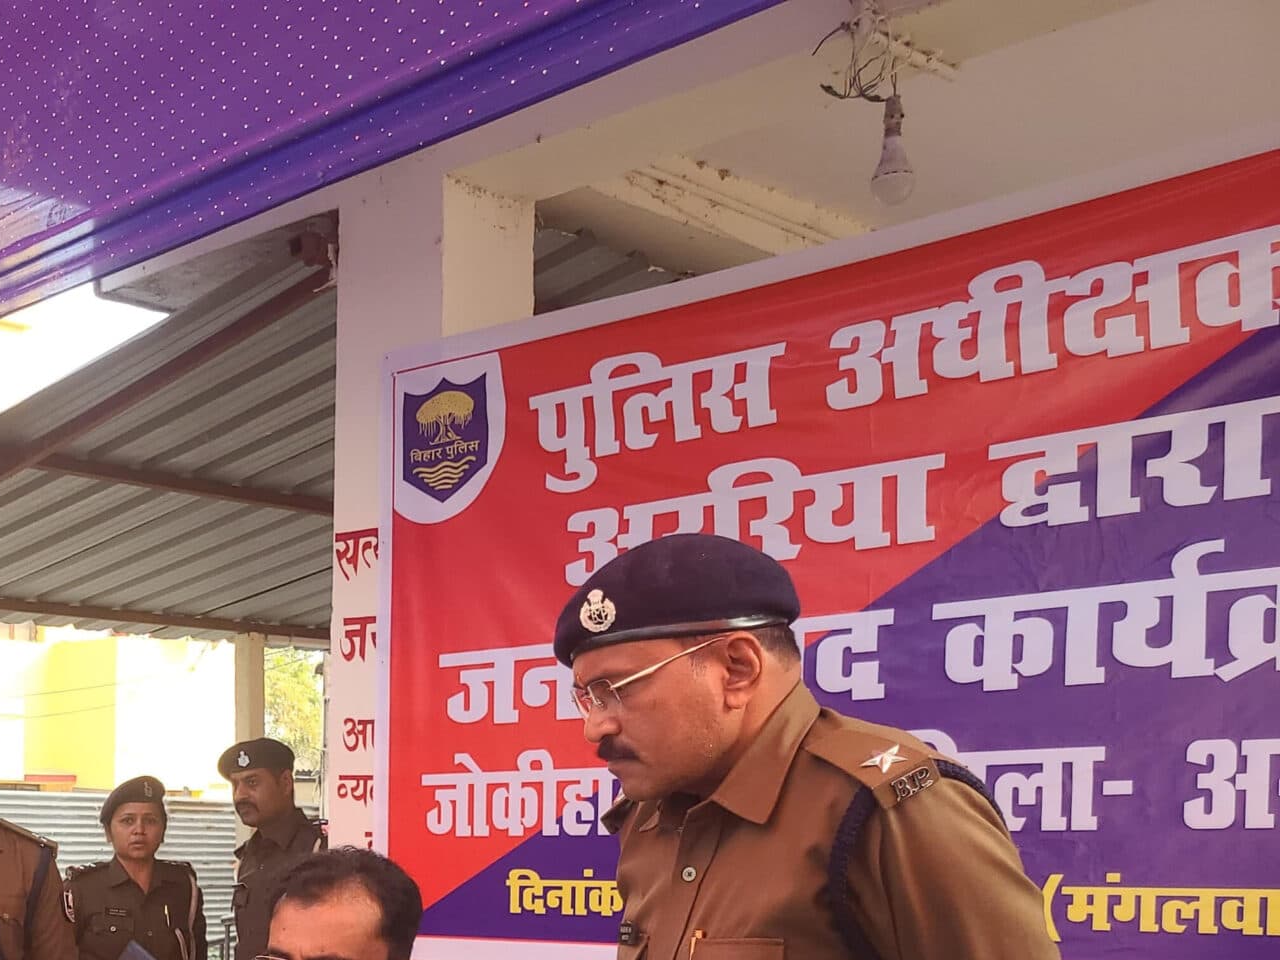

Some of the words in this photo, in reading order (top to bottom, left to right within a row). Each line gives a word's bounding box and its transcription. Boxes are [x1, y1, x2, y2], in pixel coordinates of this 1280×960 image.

[446, 440, 480, 459] पुलिस
[528, 341, 787, 494] पुलिस
[988, 396, 1280, 528] द्वारा
